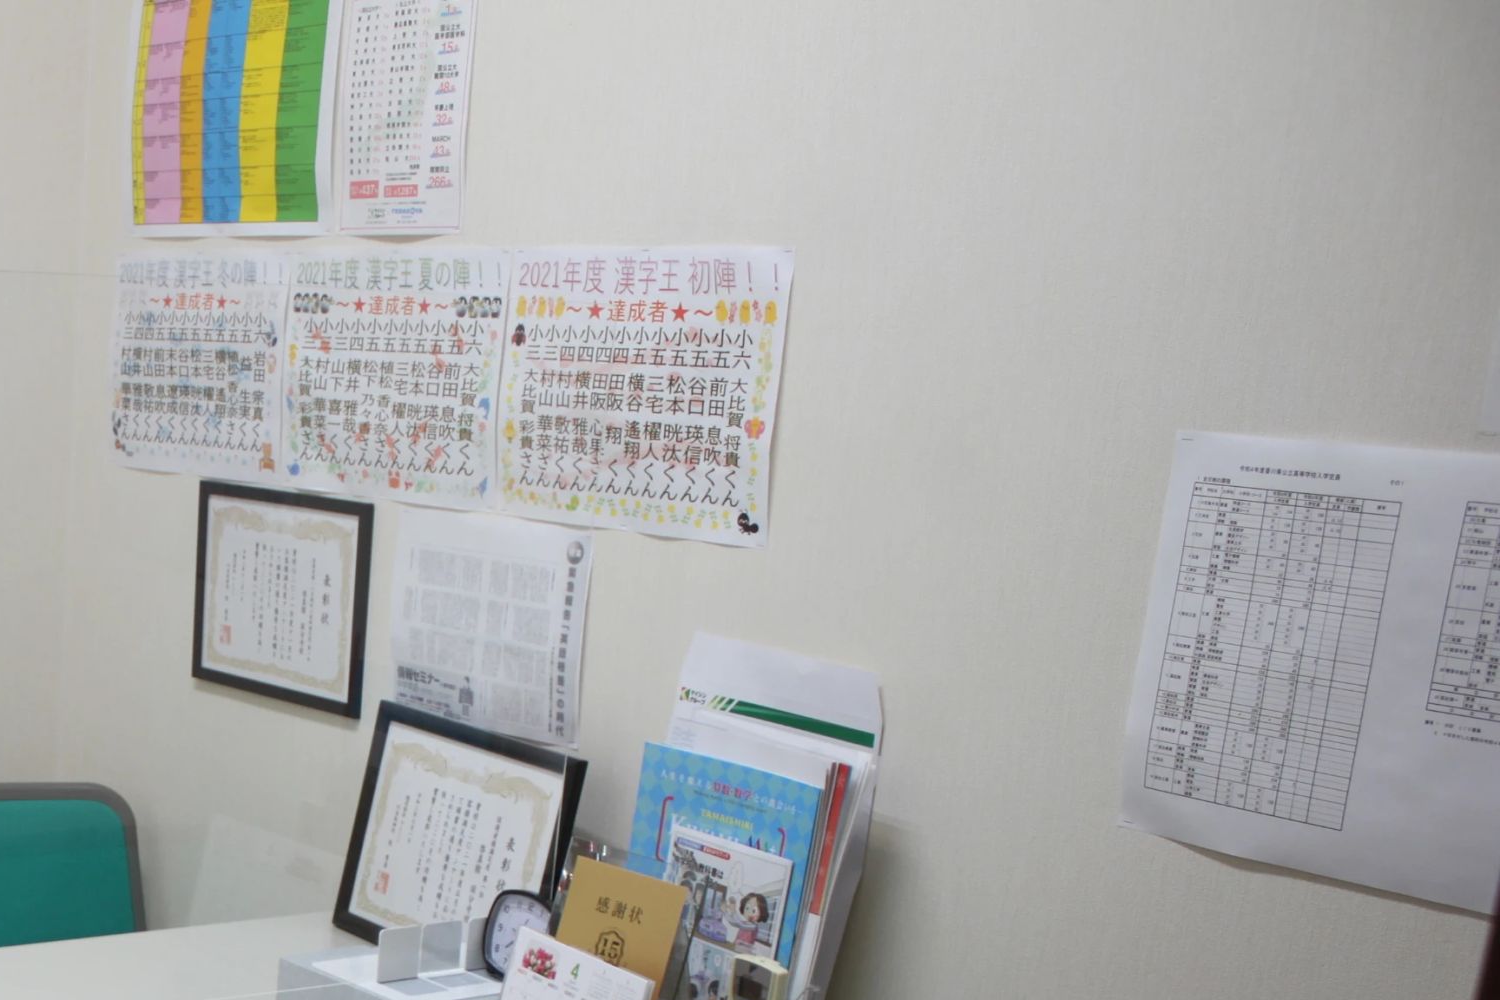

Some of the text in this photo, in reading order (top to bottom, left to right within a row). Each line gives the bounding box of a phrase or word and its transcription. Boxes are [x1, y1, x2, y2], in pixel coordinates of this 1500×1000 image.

[296, 258, 360, 290] 2021年度
[366, 256, 413, 291] 漢字王
[519, 256, 607, 293] 2021年度
[614, 256, 679, 296] 漢字王
[302, 319, 317, 350] 小三
[318, 320, 333, 352] 小三
[334, 320, 350, 351] 小三
[350, 320, 366, 352] 小四
[366, 320, 382, 353] 小五
[382, 320, 398, 353] 小五
[398, 320, 413, 354] 小五
[414, 321, 429, 354] 小五
[430, 321, 446, 355] 小五
[447, 321, 465, 356] 小五
[465, 321, 484, 356] 小六
[526, 325, 544, 361] 小三
[543, 325, 560, 362] 小三
[560, 325, 577, 363] 小四
[578, 325, 596, 363] 小四
[596, 326, 613, 364] 小四
[613, 326, 631, 364] 小四
[631, 326, 650, 365] 小五
[649, 327, 669, 367] 小五
[669, 327, 689, 368] 小五
[689, 328, 711, 368] 小五
[710, 329, 732, 369] 小五
[732, 329, 753, 370] 小六
[521, 369, 538, 413] 大比賀
[539, 369, 556, 408] 村山
[556, 371, 574, 409] 村山
[573, 371, 592, 410] 横井
[590, 373, 609, 411] 田阪
[607, 374, 625, 412] 田阪
[626, 374, 645, 413] 横谷
[645, 376, 664, 415] 三宅
[665, 375, 686, 416] 松本
[686, 376, 707, 417] 谷口
[708, 376, 729, 418] 前田
[726, 378, 748, 429] 大比賀
[596, 896, 644, 925] 感謝状
[570, 962, 581, 980] 4
